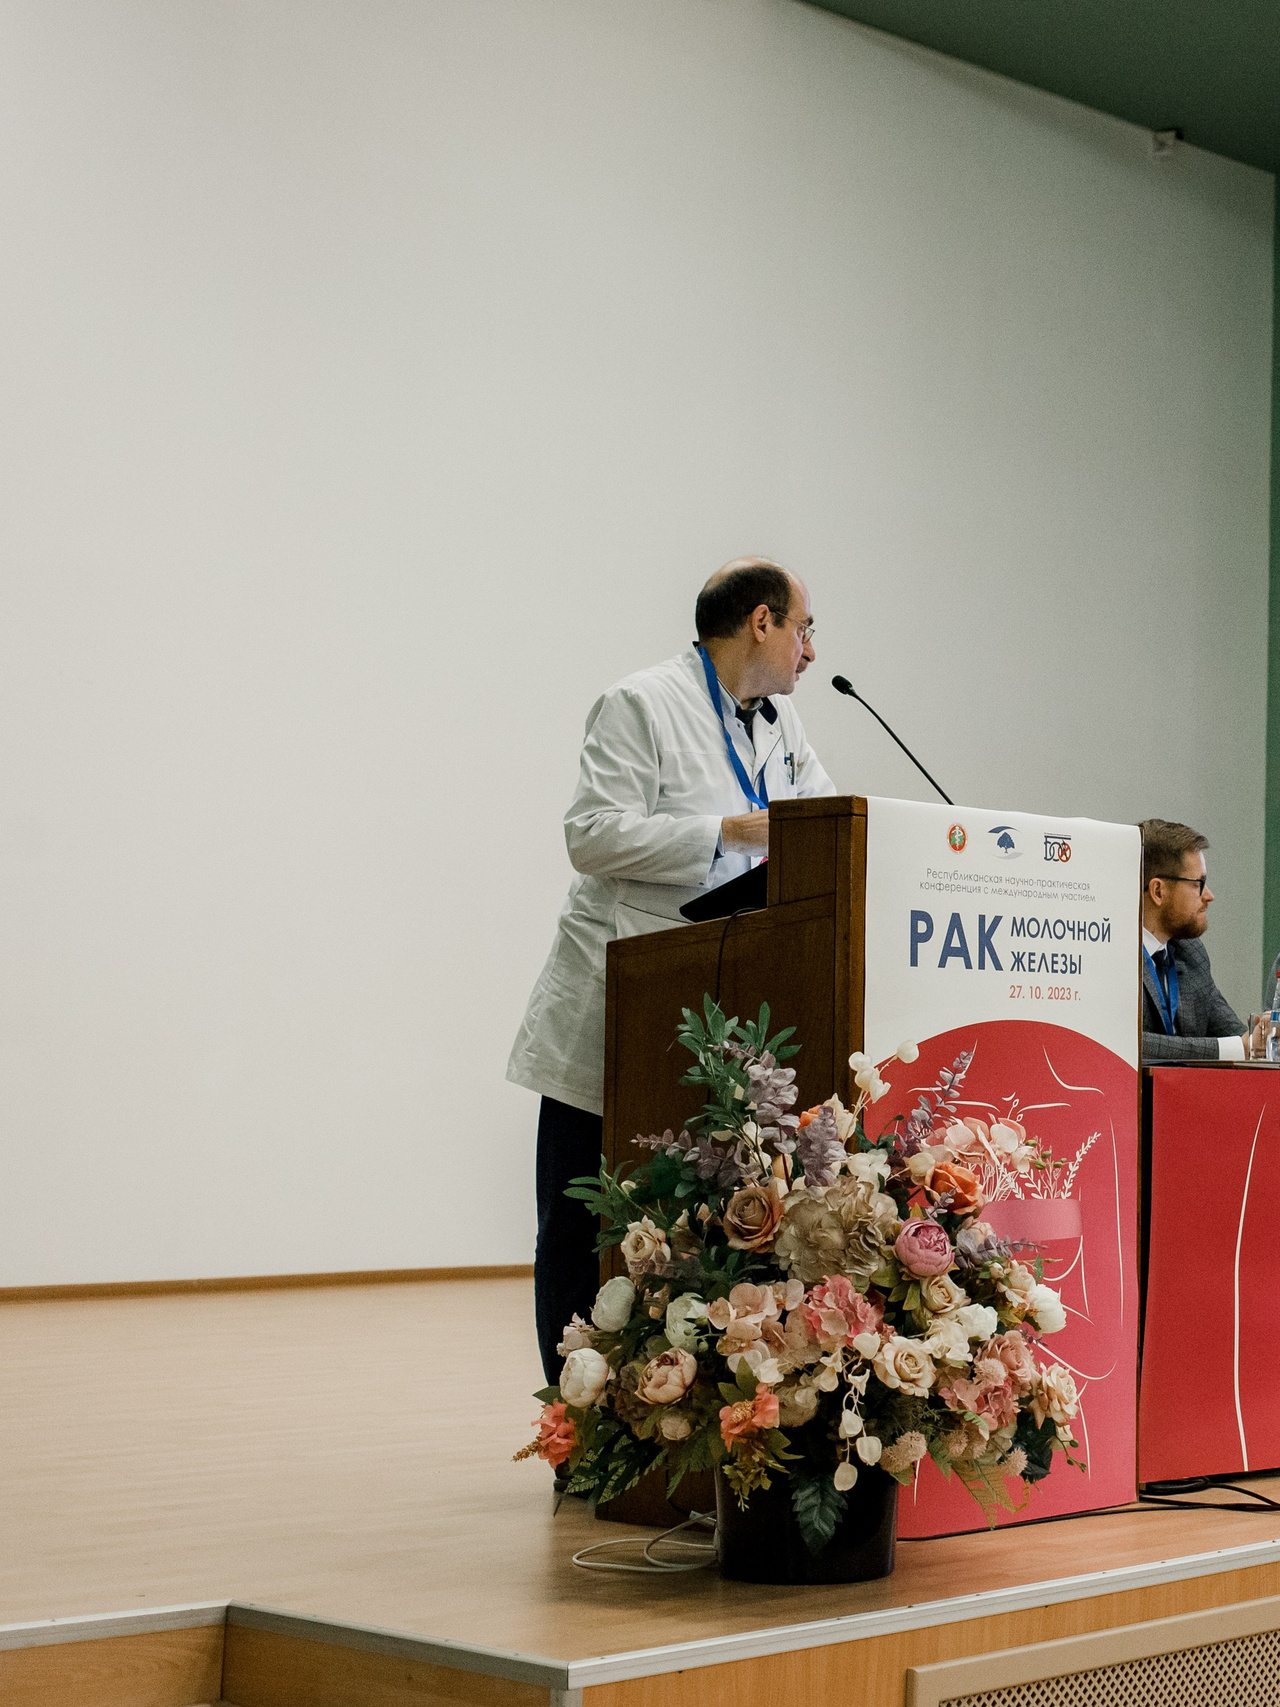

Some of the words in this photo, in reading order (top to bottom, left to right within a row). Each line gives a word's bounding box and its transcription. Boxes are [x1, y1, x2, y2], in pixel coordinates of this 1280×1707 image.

[926, 868, 1003, 884] Республиканская
[1005, 875, 1090, 891] научно-практическая
[919, 880, 982, 894] конференция
[984, 886, 989, 894] с
[991, 886, 1058, 901] международным
[1060, 891, 1096, 903] участием
[909, 909, 1004, 971] РАК
[1010, 916, 1111, 943] МОЛОЧНОЙ
[1010, 951, 1082, 975] ЖЕЛЕЗЫ
[1009, 985, 1025, 999] 27.
[1029, 986, 1044, 1000] 10.
[1047, 987, 1072, 1001] 2023
